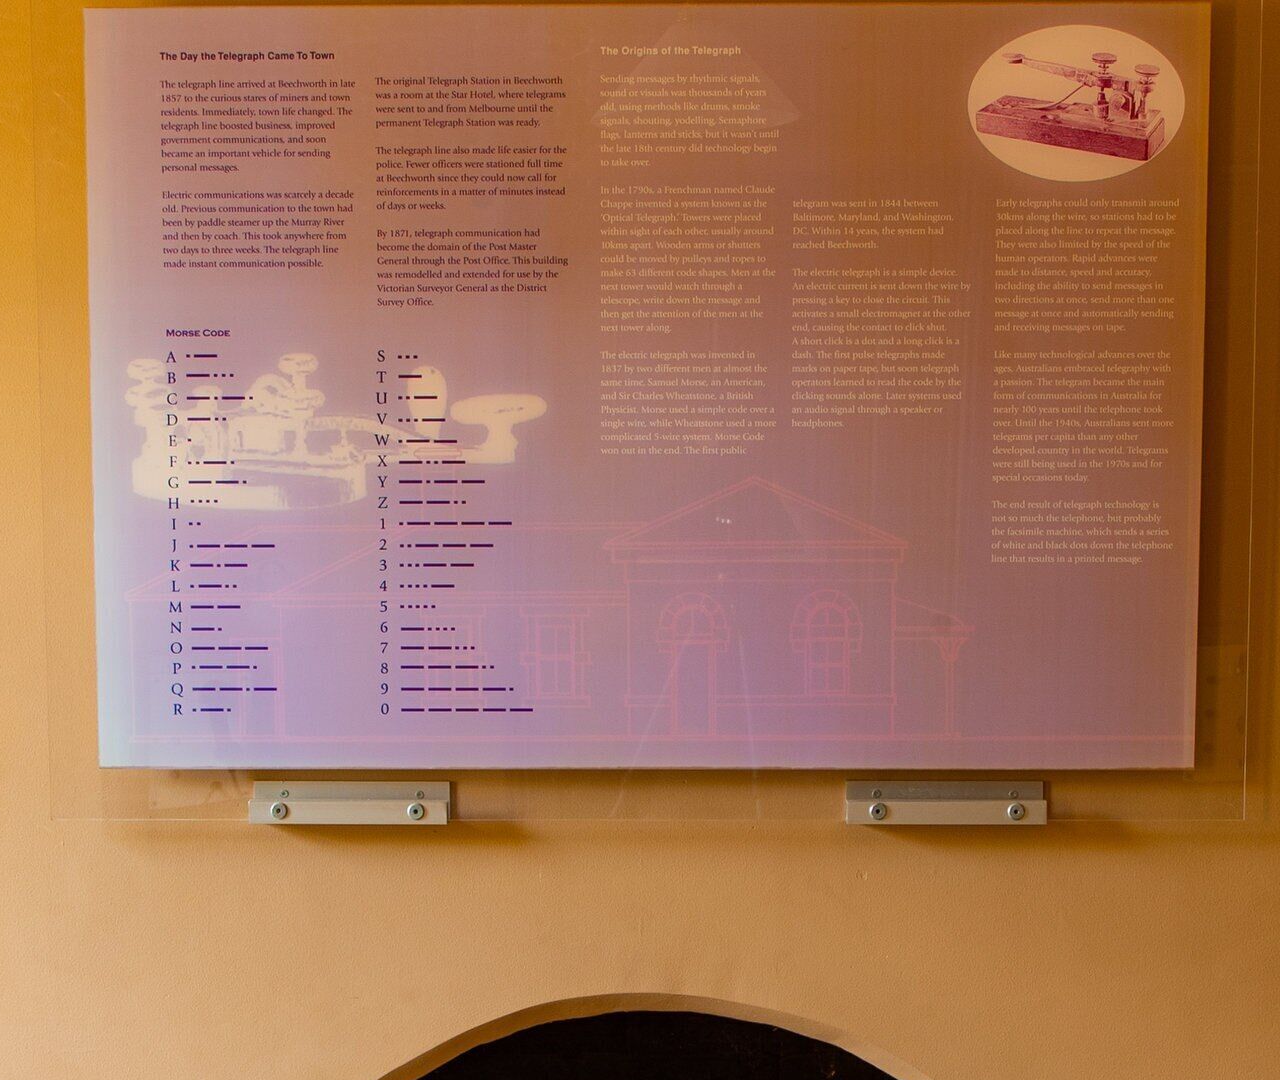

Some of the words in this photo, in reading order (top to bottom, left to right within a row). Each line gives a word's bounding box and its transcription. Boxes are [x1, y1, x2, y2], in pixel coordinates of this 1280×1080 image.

[159, 52, 178, 61] The
[180, 52, 198, 63] Day
[200, 52, 216, 61] the
[217, 51, 265, 64] Telegraph
[267, 51, 295, 60] Came
[296, 51, 308, 60] To
[309, 50, 335, 60] Town
[600, 46, 619, 56] The
[621, 46, 658, 58] Origins
[661, 46, 672, 55] of
[674, 46, 690, 56] the
[692, 45, 741, 57] Telegraph
[159, 80, 176, 89] The
[177, 79, 217, 91] telegraph
[218, 80, 235, 89] line
[236, 79, 266, 89] arrived
[278, 78, 327, 88] Beechworth
[329, 79, 338, 88] in
[340, 78, 356, 88] late
[374, 76, 392, 86] The
[392, 76, 426, 88] original
[427, 76, 468, 88] Telegraph
[470, 74, 500, 86] Station
[502, 76, 512, 85] in
[514, 75, 563, 85] Beechworth
[600, 74, 635, 86] Sending
[636, 76, 676, 86] messages
[676, 74, 688, 85] by
[689, 74, 728, 86] rhythmic
[729, 74, 760, 86] signals,
[161, 93, 181, 103] 1857
[184, 93, 193, 103] to
[195, 93, 209, 103] the
[210, 93, 242, 103] curious
[243, 93, 267, 103] stares
[269, 93, 279, 103] of
[279, 93, 309, 103] miners
[310, 93, 327, 103] and
[329, 93, 350, 103] town
[792, 198, 829, 210] telegram
[831, 200, 848, 208] was
[848, 200, 866, 208] sent
[868, 198, 878, 208] in
[880, 198, 901, 208] 1844
[903, 198, 939, 208] between
[996, 198, 1017, 208] Early
[1019, 198, 1062, 208] telegraphs
[1064, 198, 1088, 208] could
[1090, 198, 1109, 208] only
[1111, 198, 1147, 208] transmit
[1148, 198, 1180, 208] around
[793, 212, 836, 222] Baltimore,
[838, 212, 881, 224] Maryland,
[882, 212, 900, 222] and
[900, 212, 955, 224] Washington,
[376, 256, 410, 265] General
[411, 256, 446, 267] through
[447, 256, 461, 265] the
[463, 256, 481, 265] Post
[482, 255, 510, 265] Office.
[512, 256, 531, 265] This
[532, 255, 569, 266] building
[166, 329, 201, 337] MORSE
[202, 329, 231, 337] CODE
[166, 351, 177, 363] A
[377, 350, 386, 363] S
[600, 351, 616, 359] The
[618, 351, 647, 359] electric
[649, 351, 689, 359] telegraph
[690, 351, 707, 359] was
[708, 351, 745, 359] invented
[747, 351, 756, 359] in
[167, 372, 176, 384] B
[376, 371, 387, 383] T
[166, 393, 178, 405] C
[376, 392, 388, 404] U
[166, 414, 178, 425] D
[376, 413, 388, 425] V
[169, 435, 177, 447] E
[374, 434, 389, 446] W
[169, 456, 177, 467] F
[377, 455, 388, 467] X
[168, 476, 179, 489] G
[377, 476, 388, 487] Y
[168, 497, 179, 509] H
[377, 497, 388, 509] Z
[171, 539, 177, 553] J
[379, 539, 387, 550] 2
[170, 559, 181, 571] K
[379, 560, 387, 571] 3
[991, 554, 1008, 563] line
[1009, 554, 1027, 563] that
[1028, 554, 1055, 563] results
[1056, 554, 1066, 563] in
[1074, 554, 1105, 566] printed
[1106, 556, 1143, 566] message.
[172, 580, 180, 592] L
[379, 580, 388, 592] 4
[169, 601, 183, 613] M
[380, 601, 388, 613] 5
[170, 622, 182, 633] N
[380, 622, 388, 633] 6
[170, 642, 183, 655] O
[380, 642, 388, 654] 7
[173, 663, 182, 674] P
[380, 663, 388, 674] 8
[171, 683, 184, 697] Q
[380, 683, 388, 695] 9
[173, 704, 183, 715] R
